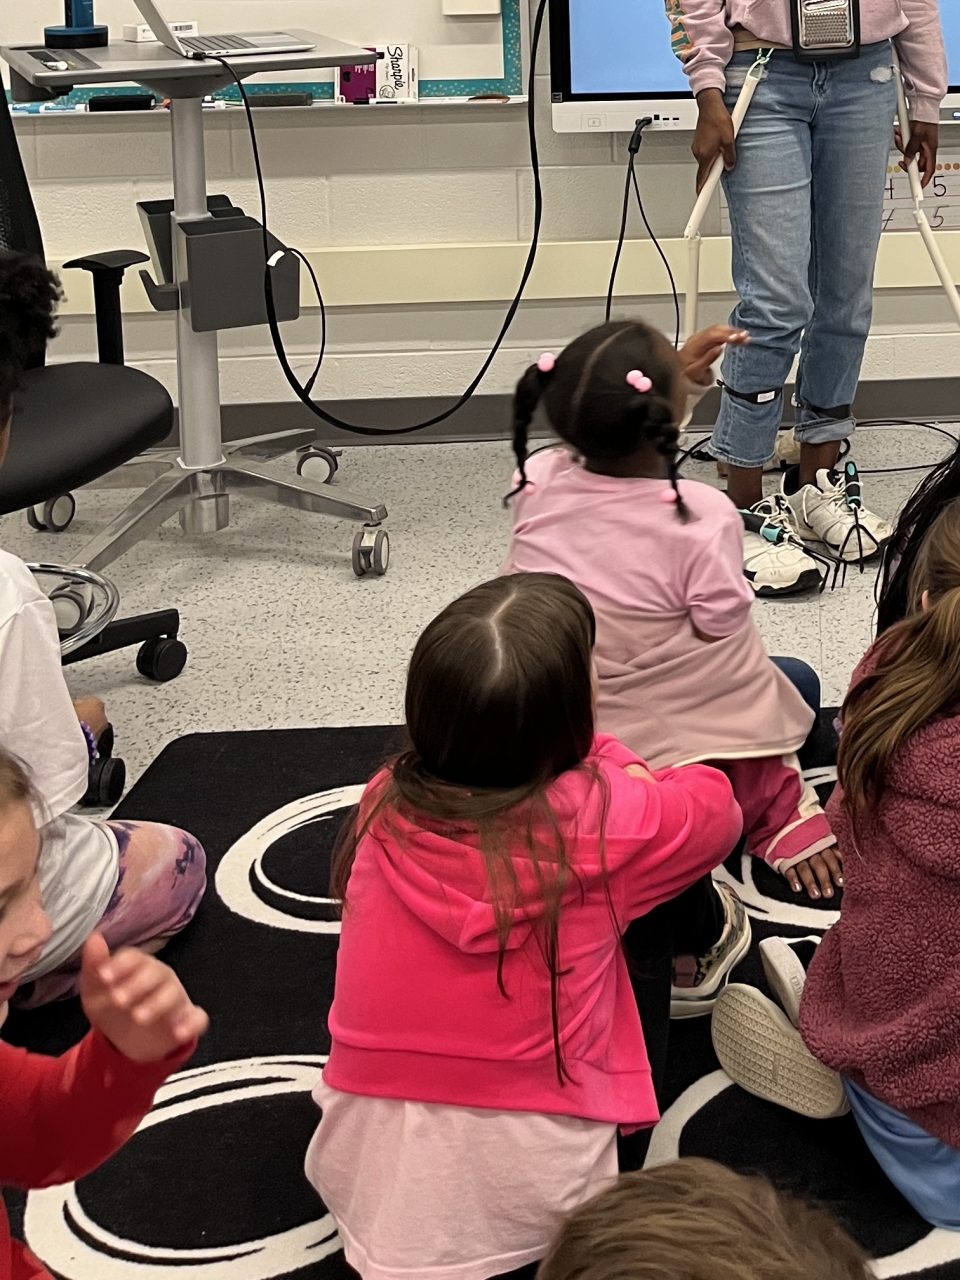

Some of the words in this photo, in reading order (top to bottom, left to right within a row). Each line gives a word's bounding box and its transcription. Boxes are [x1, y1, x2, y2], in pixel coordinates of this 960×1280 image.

[387, 46, 406, 90] Sharpie
[933, 175, 947, 197] 5
[929, 205, 949, 228] 5
